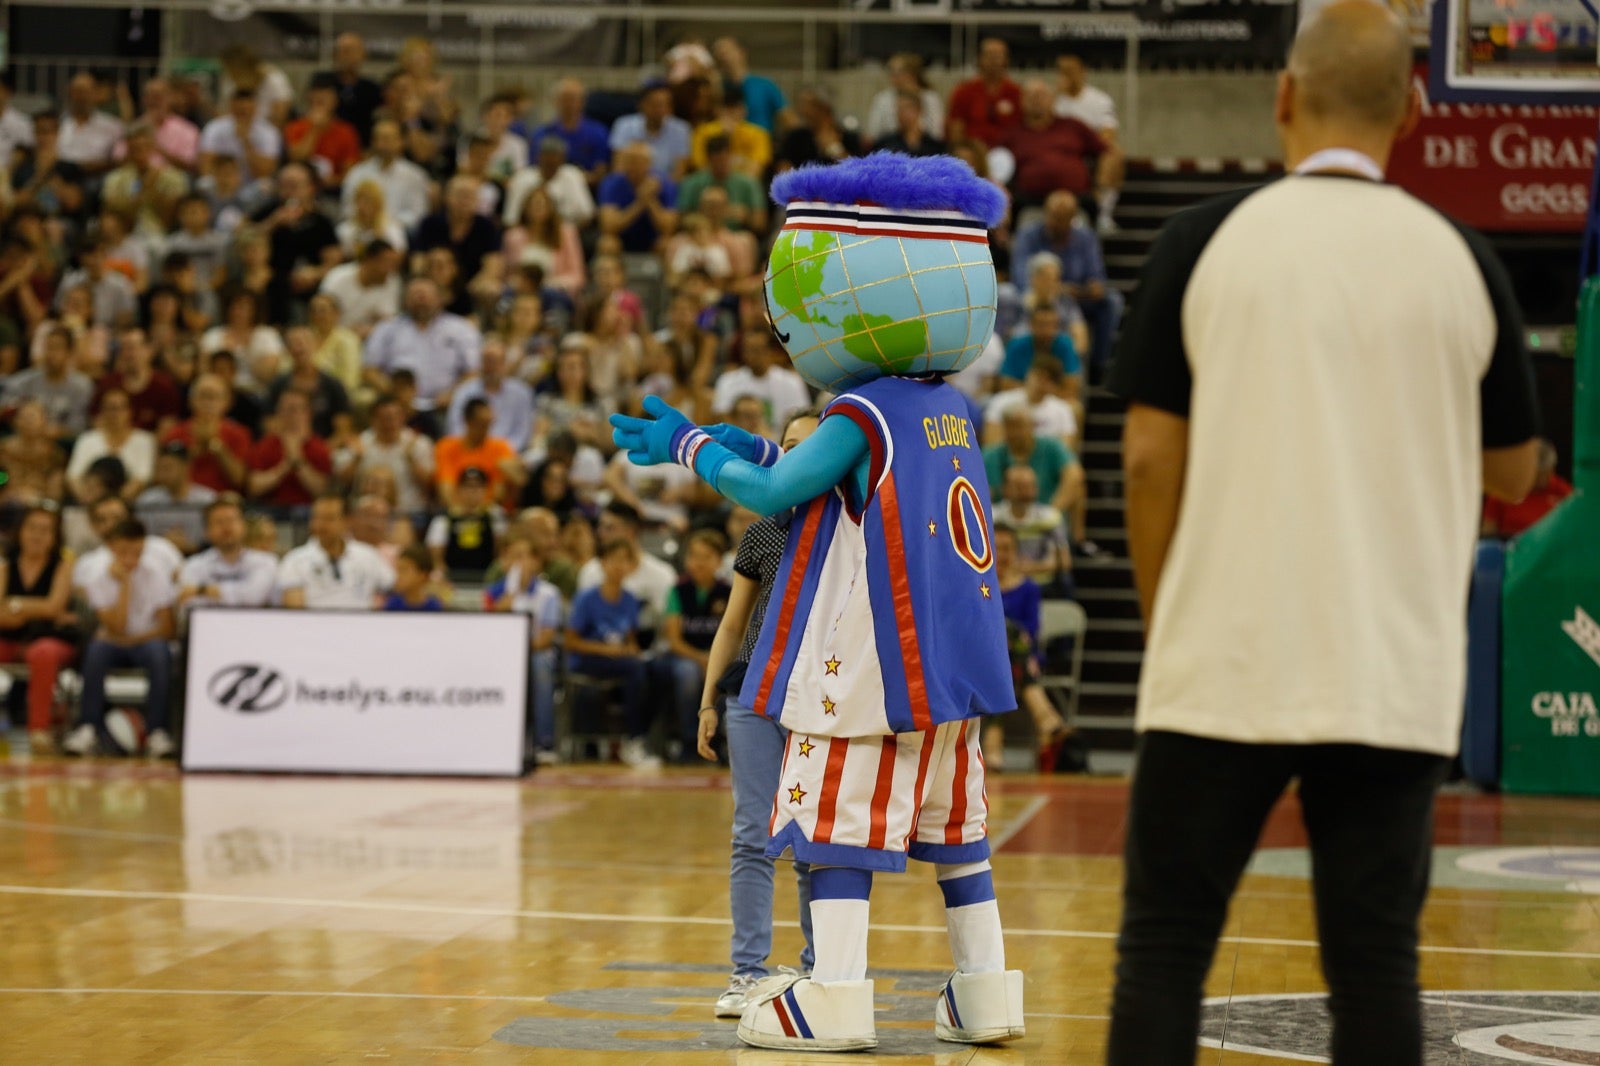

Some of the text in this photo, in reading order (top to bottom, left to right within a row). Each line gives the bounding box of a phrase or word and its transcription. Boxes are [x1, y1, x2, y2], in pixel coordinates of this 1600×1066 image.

[922, 413, 970, 450] GLOBIE
[947, 476, 993, 573] 0
[297, 680, 504, 711] heelys.eu.com
[1532, 692, 1598, 718] CAJA
